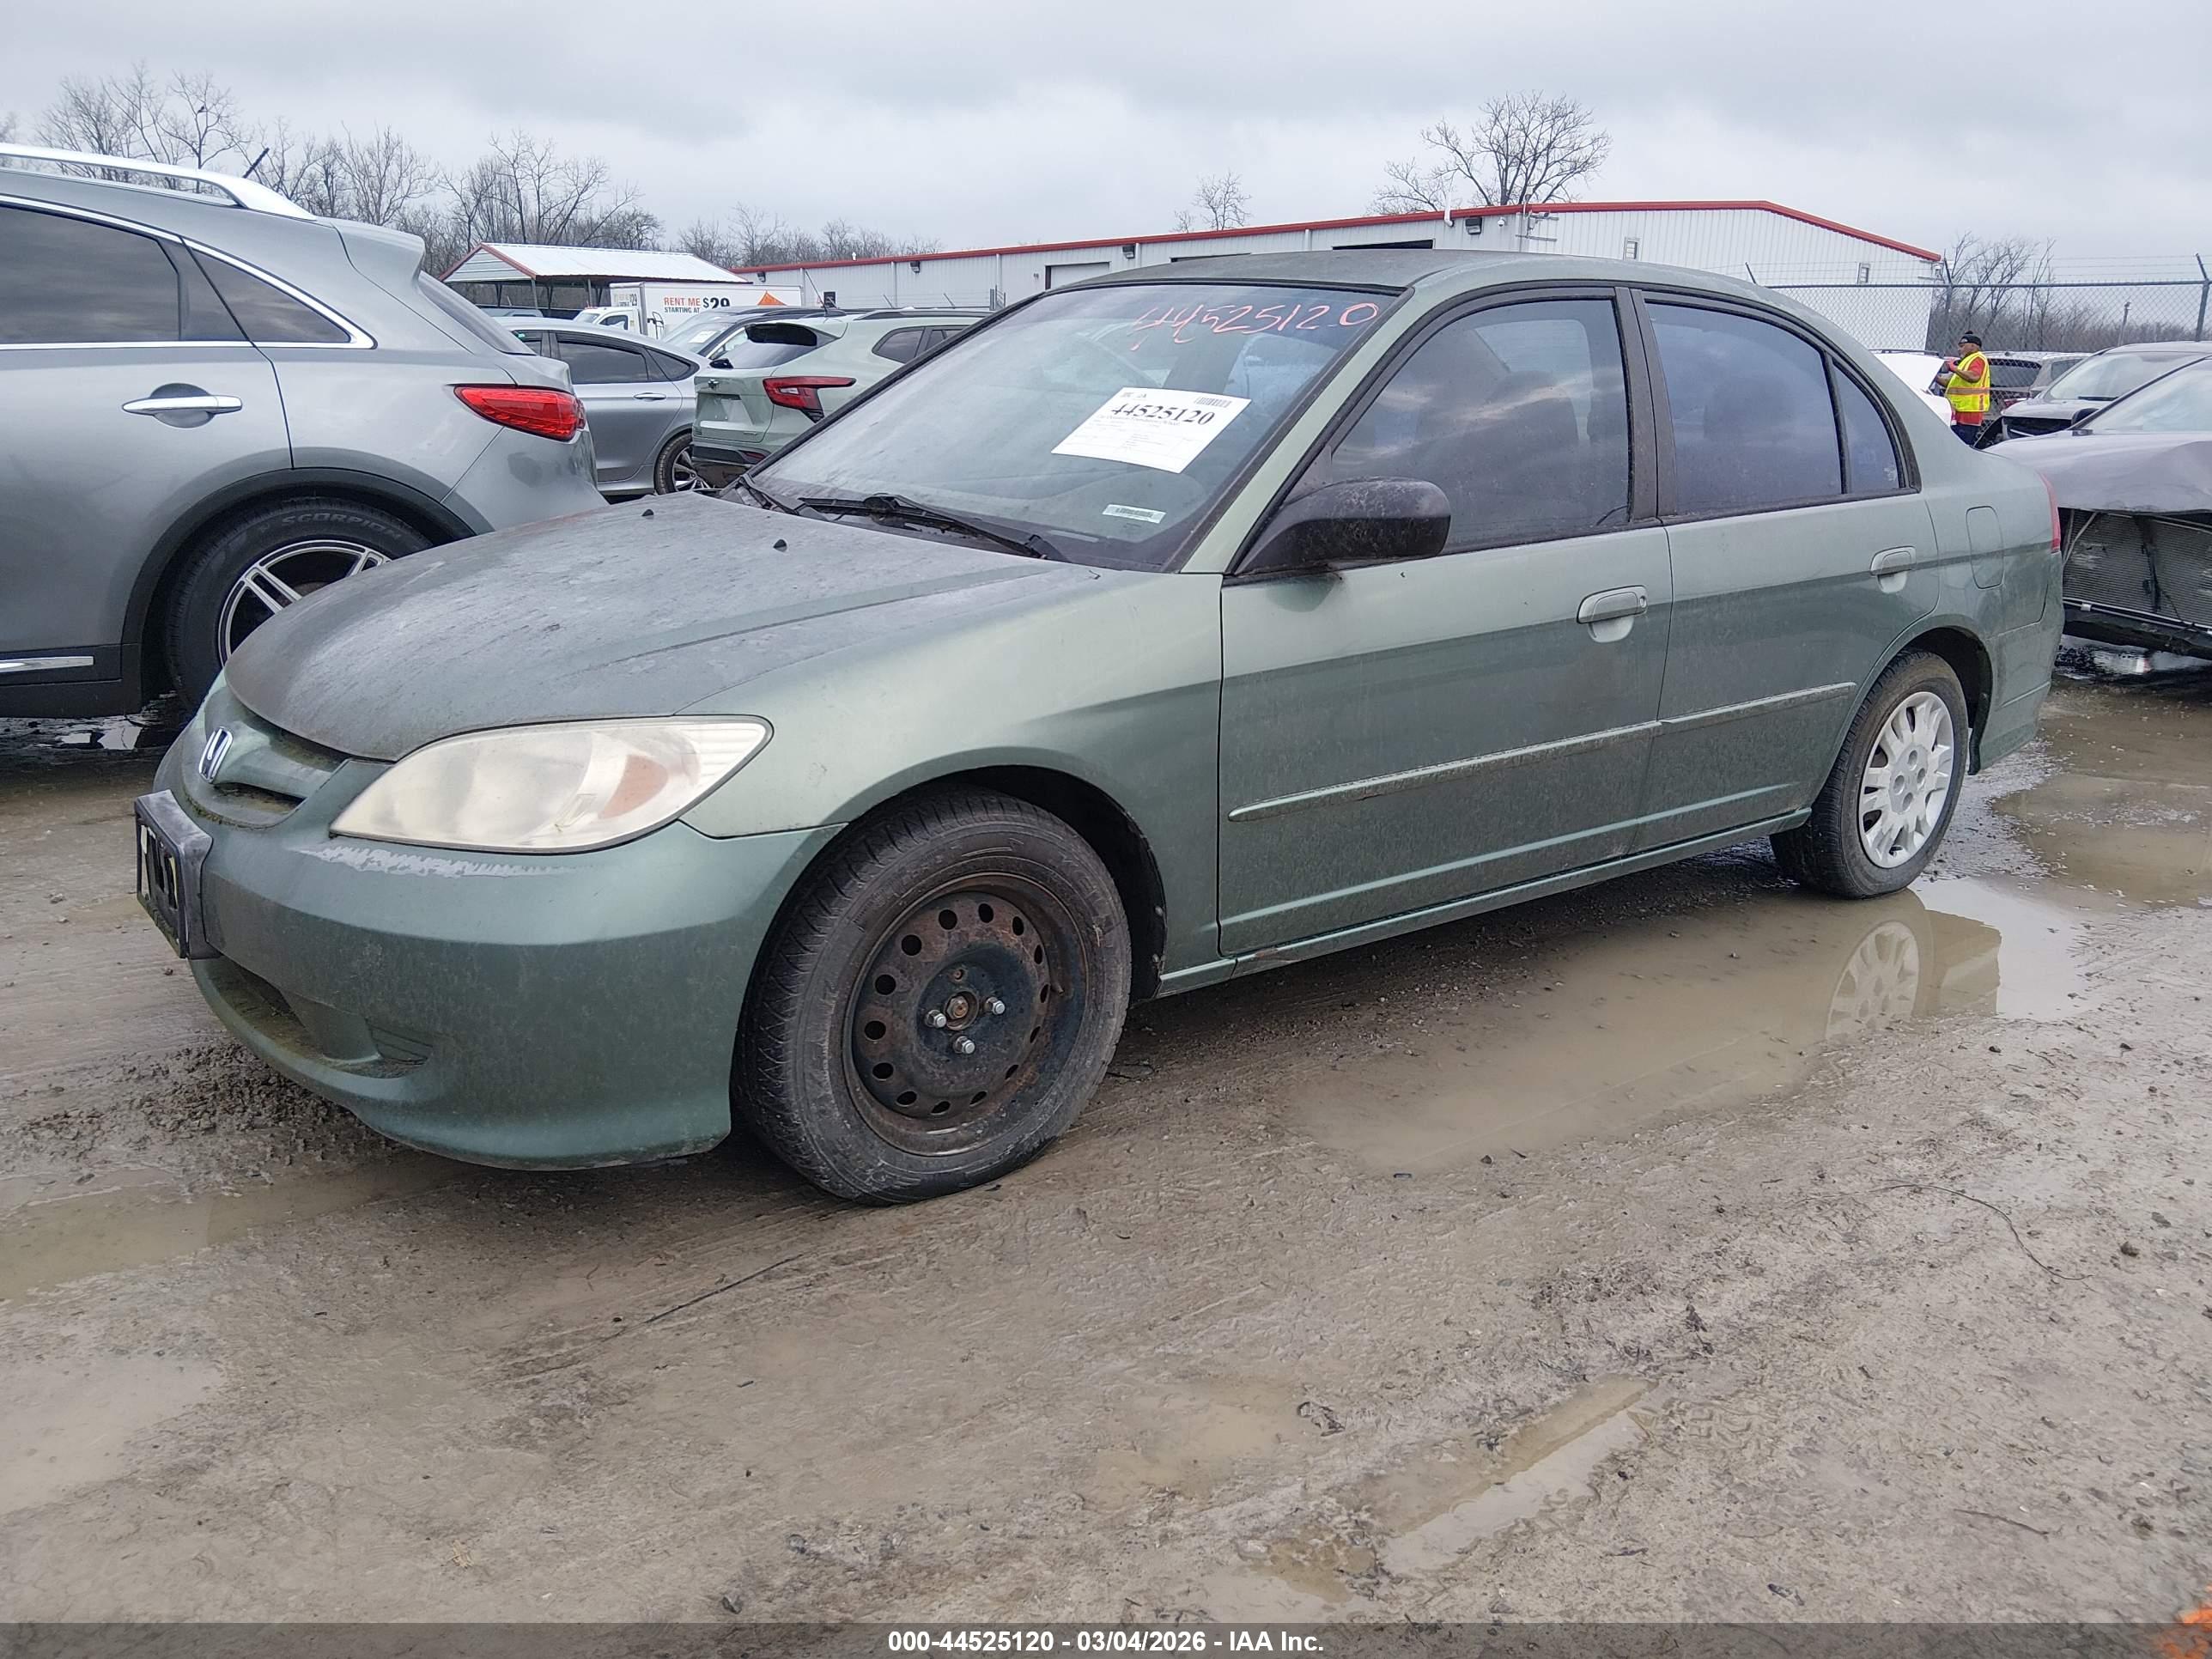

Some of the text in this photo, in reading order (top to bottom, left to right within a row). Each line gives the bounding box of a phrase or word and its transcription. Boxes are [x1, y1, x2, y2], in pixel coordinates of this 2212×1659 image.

[663, 296, 685, 307] RENT
[688, 296, 701, 307] ME
[1111, 402, 1216, 426] 44525120
[281, 513, 402, 540] SCORPION
